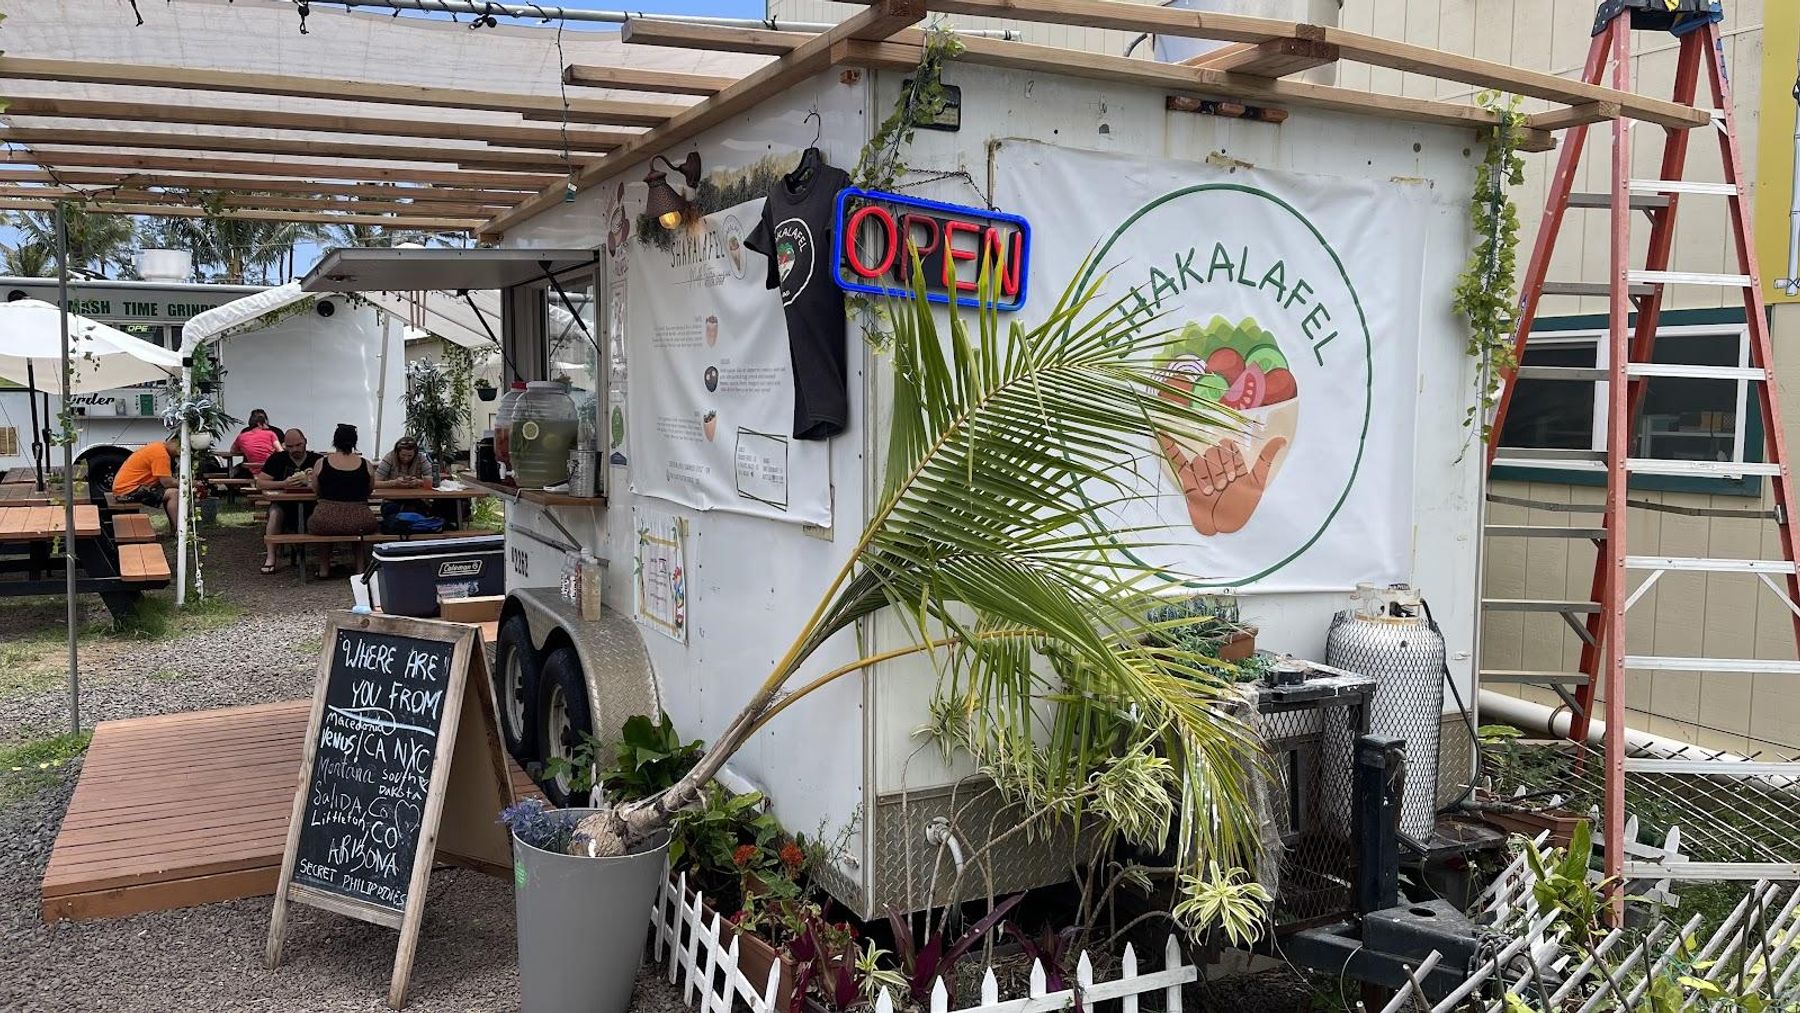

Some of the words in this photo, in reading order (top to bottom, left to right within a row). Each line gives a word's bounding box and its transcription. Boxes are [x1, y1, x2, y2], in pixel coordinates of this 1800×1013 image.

[846, 205, 1021, 295] OPEN
[58, 300, 110, 314] MASH
[123, 302, 158, 316] TIME
[1100, 241, 1338, 367] SHAKALAFEL
[444, 562, 471, 572] Coleman
[342, 638, 397, 674] WHERE
[404, 650, 439, 681] ARE
[352, 679, 382, 708] YOU
[389, 681, 443, 720] FROM
[317, 755, 375, 784] Montana
[300, 858, 337, 882] SECRET
